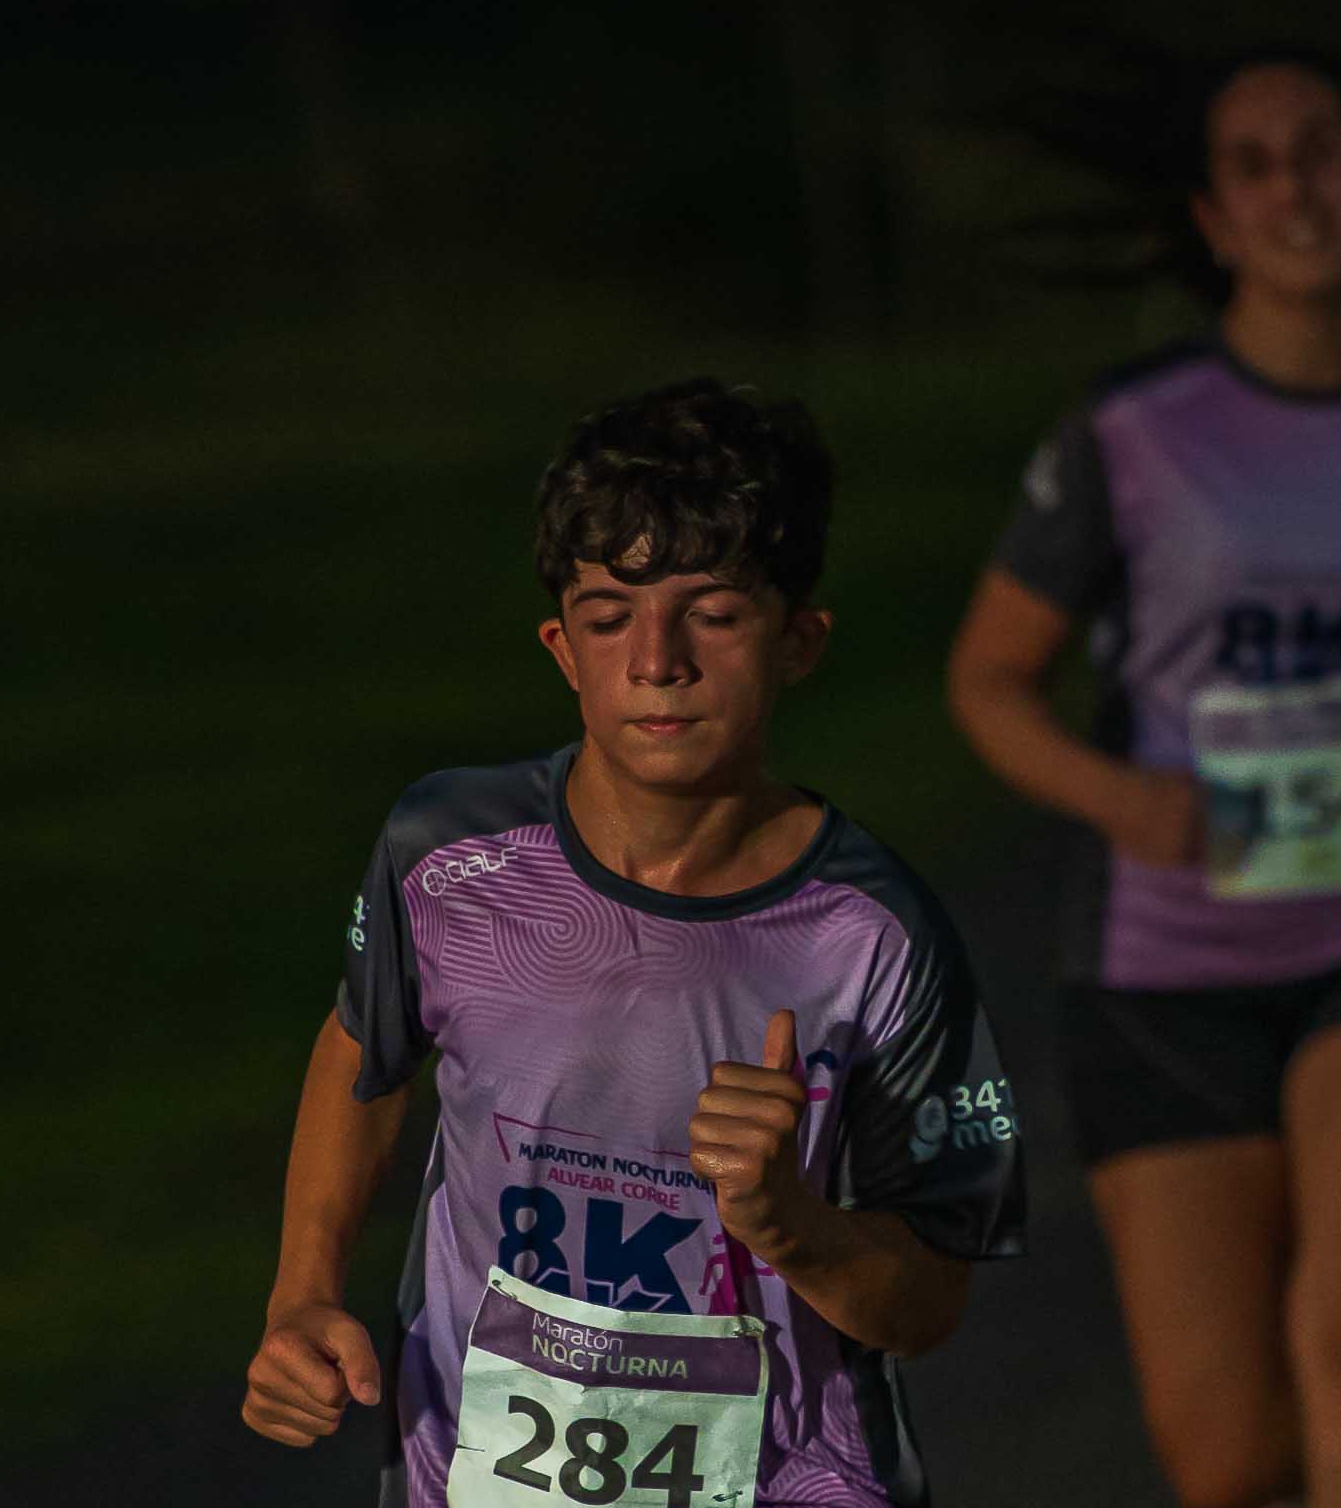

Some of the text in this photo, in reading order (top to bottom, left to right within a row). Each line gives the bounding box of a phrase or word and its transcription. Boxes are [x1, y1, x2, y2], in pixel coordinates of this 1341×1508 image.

[518, 1142, 606, 1170] MARATON
[548, 1167, 681, 1211] ALVEAR CORRE
[498, 1185, 704, 1313] 8K
[532, 1312, 624, 1352] Maratón
[532, 1335, 689, 1379] NOCTURNA
